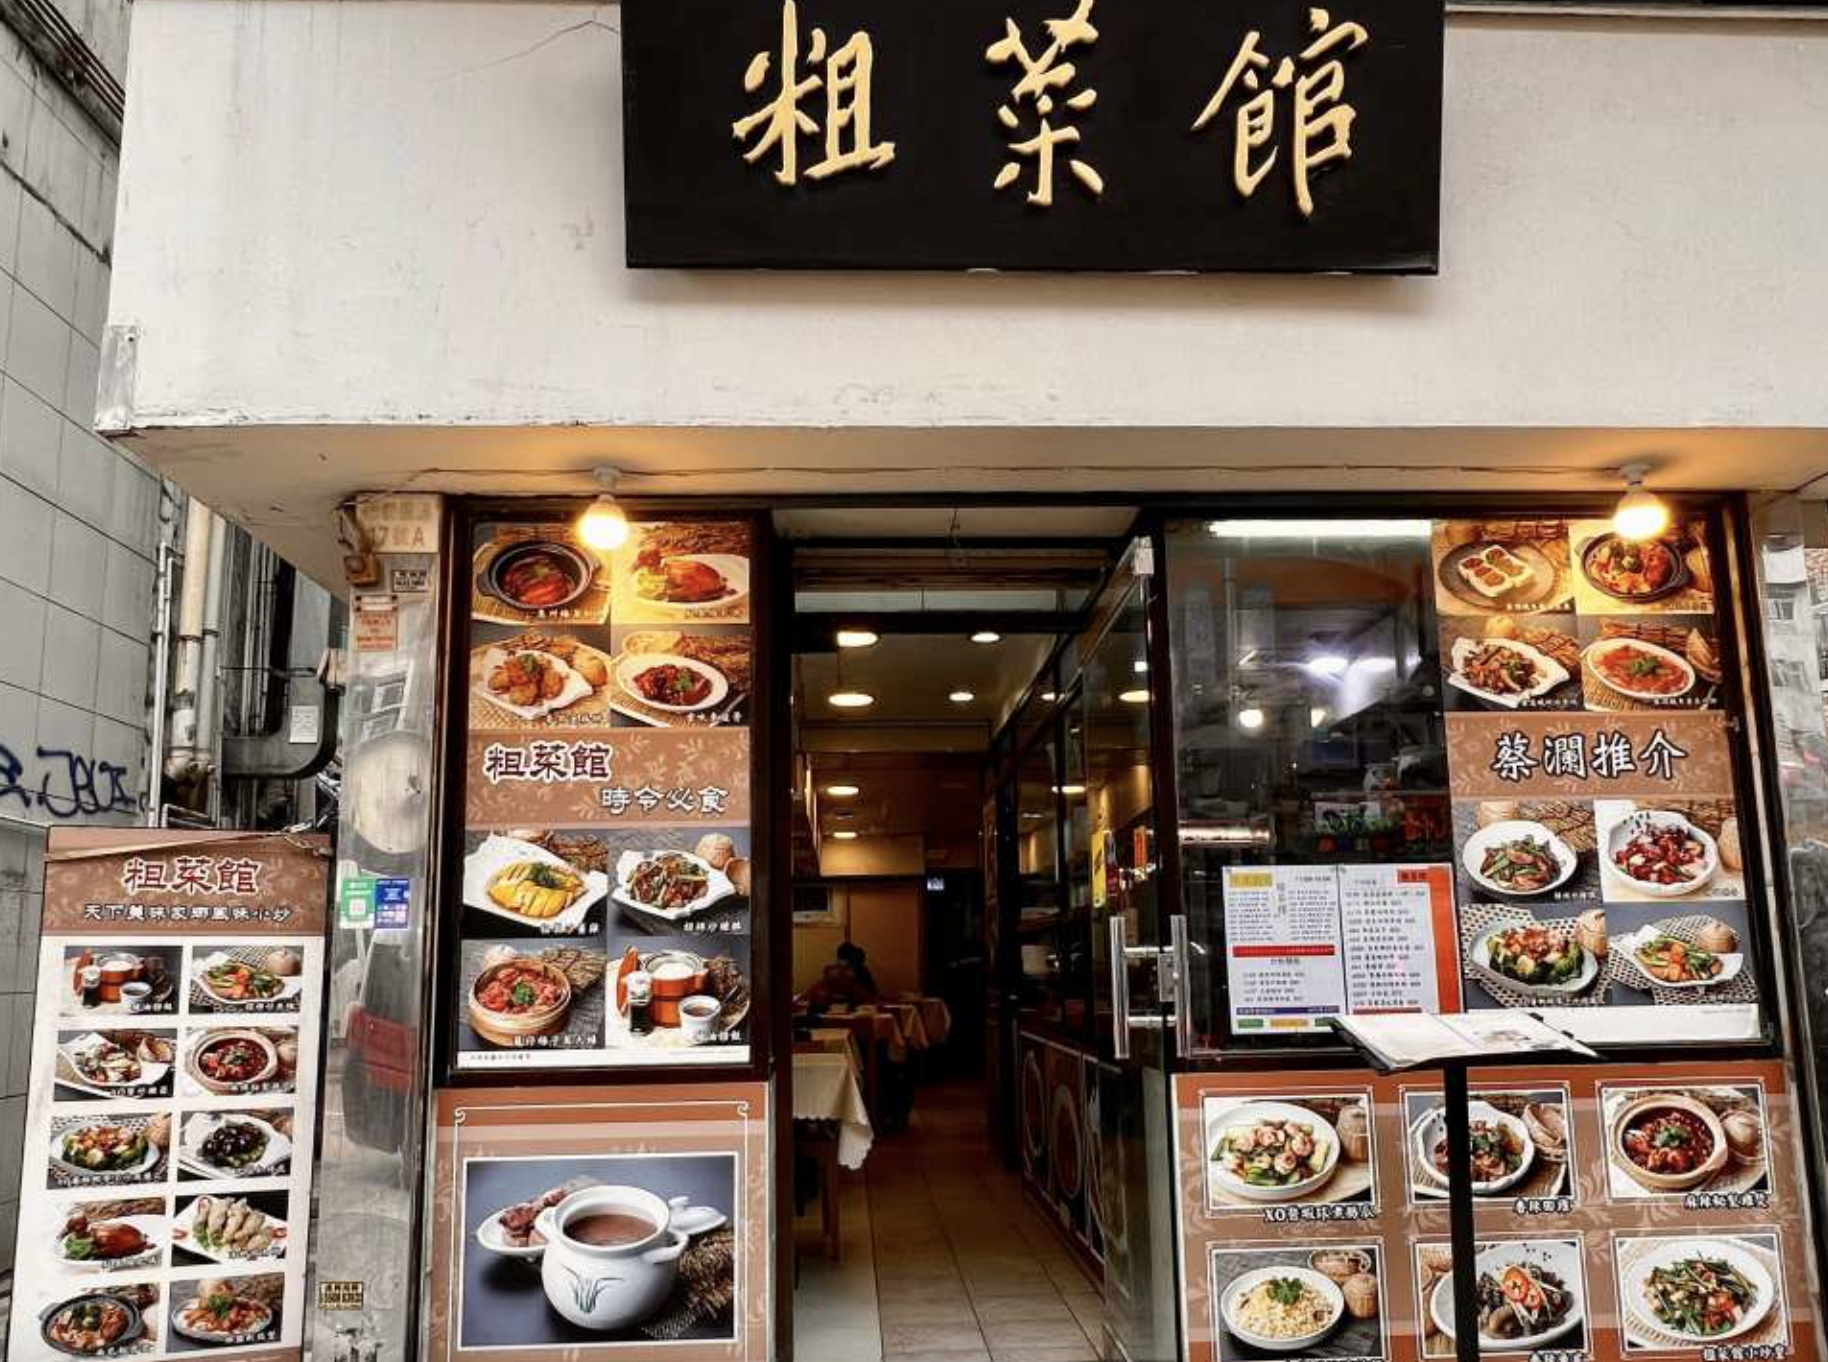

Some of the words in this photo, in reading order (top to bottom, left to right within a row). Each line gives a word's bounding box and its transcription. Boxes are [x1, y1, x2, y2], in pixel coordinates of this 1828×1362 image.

[732, 0, 1368, 215] 粗菜館
[485, 743, 611, 781] 粗菜館
[1492, 730, 1687, 780] 蔡瀾推介
[602, 786, 729, 815] 時令必食
[123, 857, 260, 894] 粗菜館
